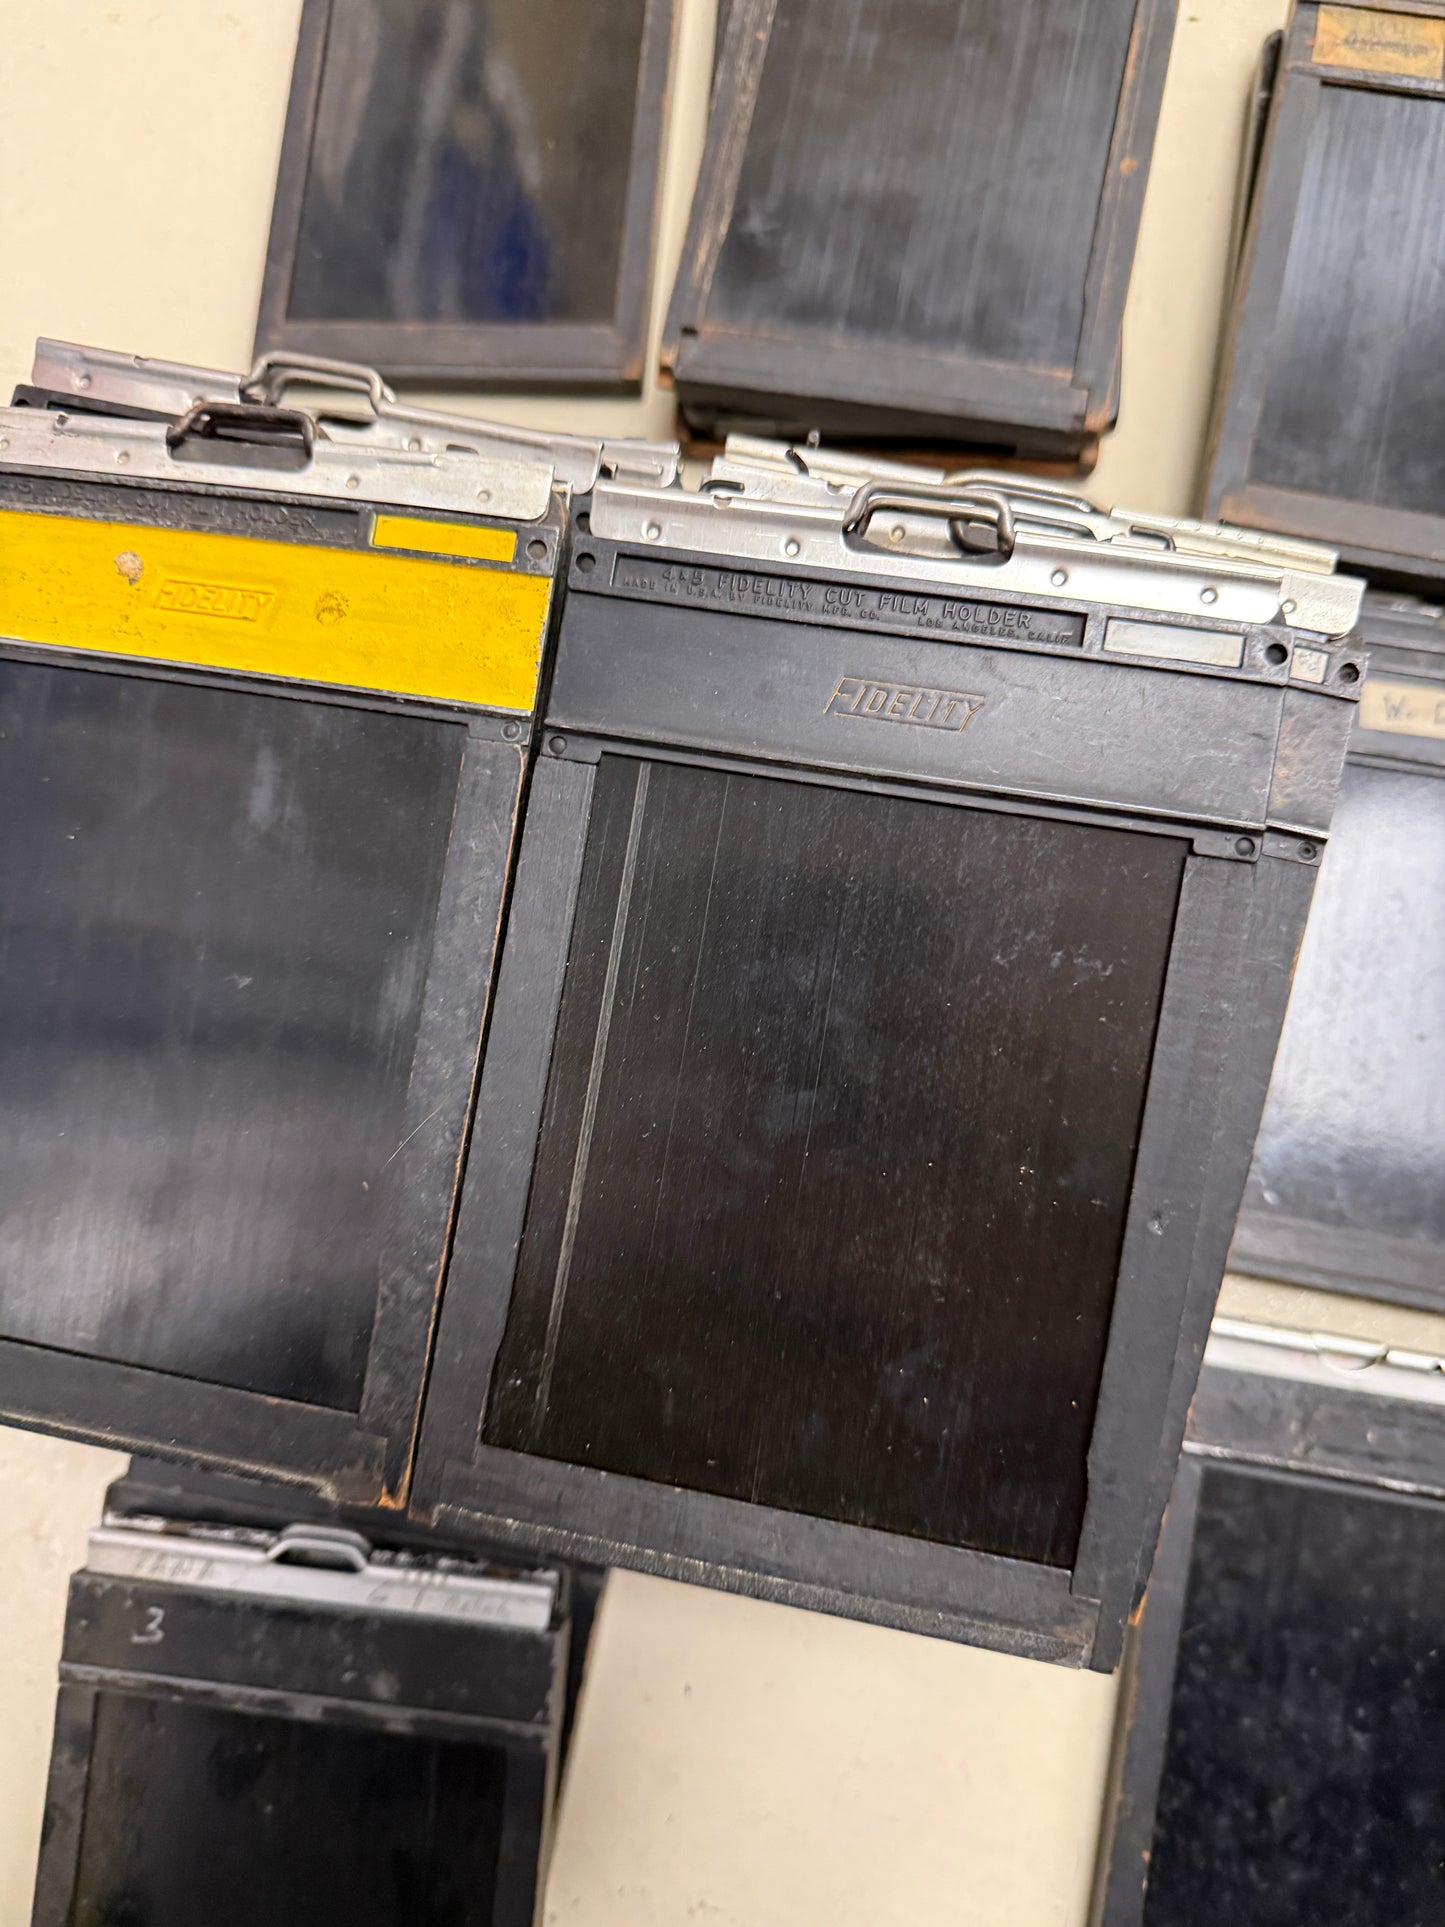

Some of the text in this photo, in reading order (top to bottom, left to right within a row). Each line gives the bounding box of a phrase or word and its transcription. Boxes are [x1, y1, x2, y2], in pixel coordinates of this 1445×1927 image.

[153, 578, 276, 622] FIDELITY
[622, 576, 656, 592] MADE
[752, 594, 815, 613] FIDELITY
[821, 603, 852, 618] MFG.
[859, 608, 881, 621] CO.
[917, 616, 945, 629] LOS
[717, 572, 813, 600] FIDELITY
[825, 586, 866, 609] CUT
[878, 593, 930, 617] FILM
[942, 601, 1032, 630] HOLDER
[823, 677, 986, 733] FIDELITY
[130, 1605, 165, 1644] 3
